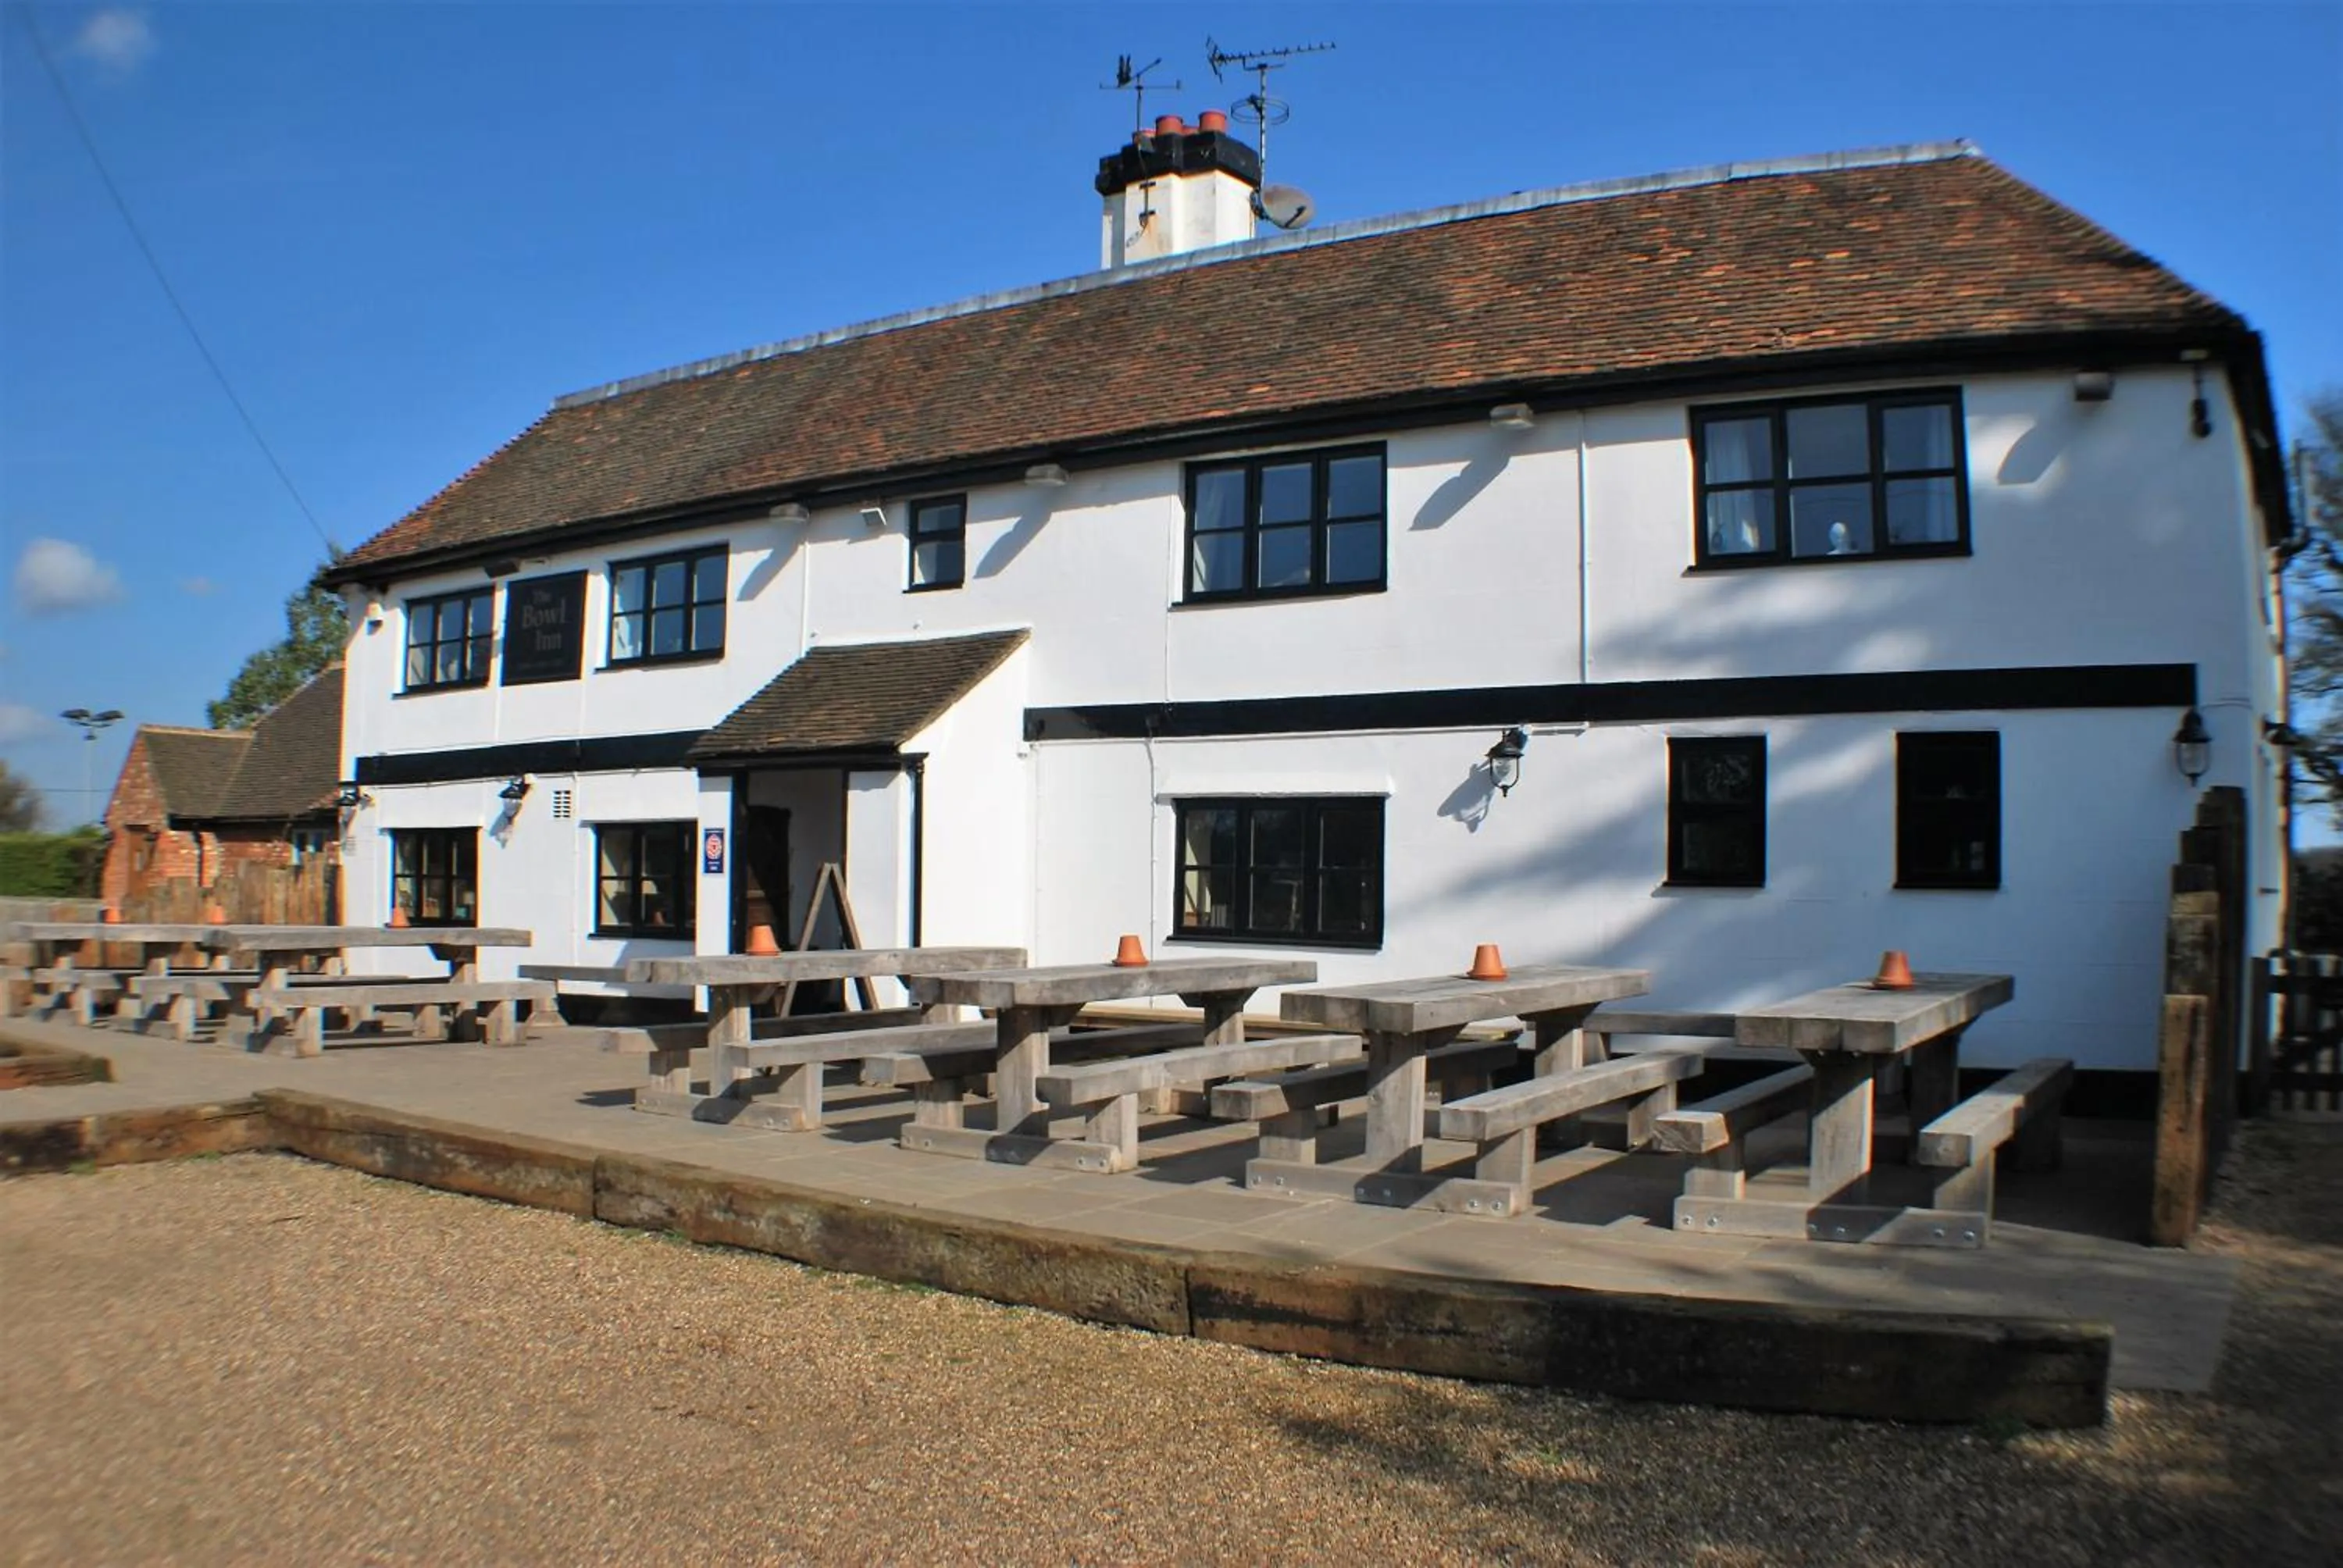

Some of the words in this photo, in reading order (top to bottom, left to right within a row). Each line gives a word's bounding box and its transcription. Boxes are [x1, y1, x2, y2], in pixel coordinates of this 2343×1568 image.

[532, 590, 551, 604] The
[522, 597, 566, 629] Bowl
[536, 629, 562, 651] Inn
